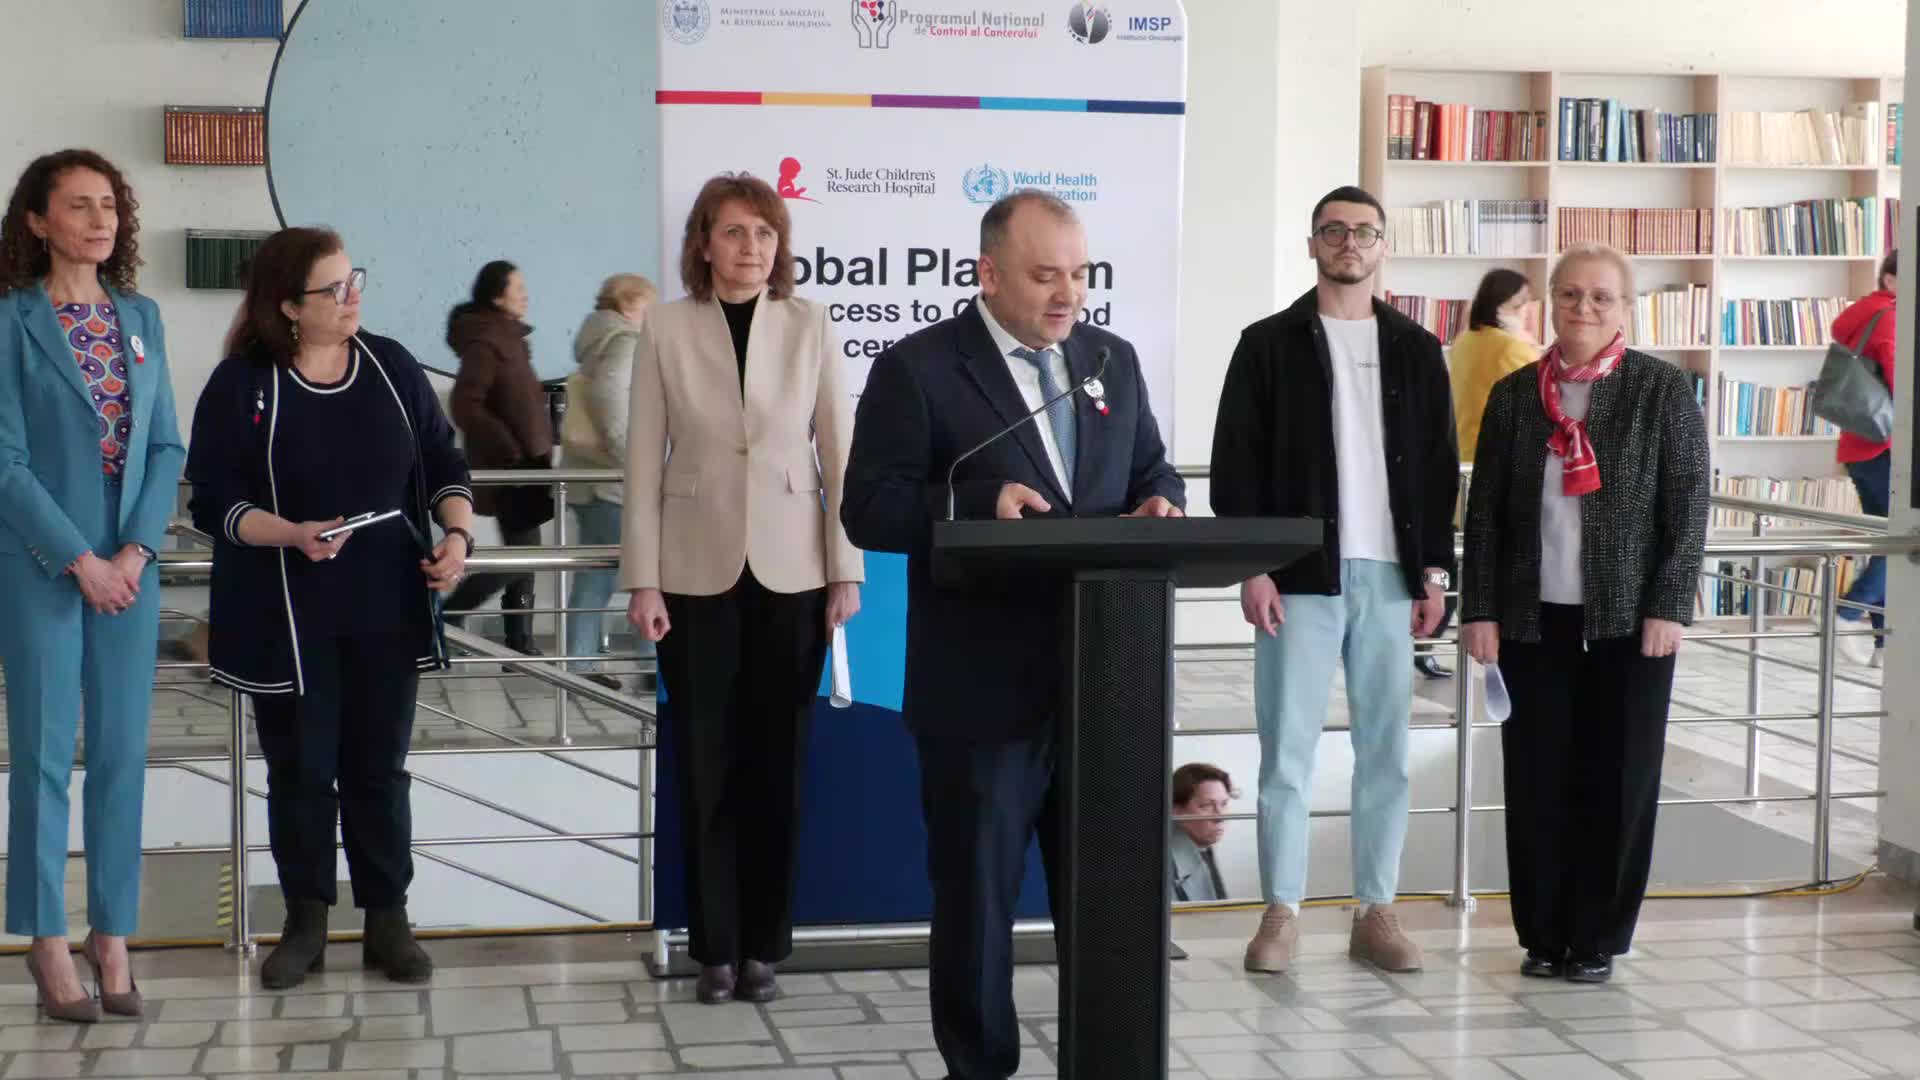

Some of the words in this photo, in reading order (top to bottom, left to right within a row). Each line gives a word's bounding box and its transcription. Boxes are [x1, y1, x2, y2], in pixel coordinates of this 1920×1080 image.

[900, 9, 976, 26] Programul
[1128, 17, 1171, 31] IMSP
[914, 25, 927, 36] de
[930, 26, 967, 37] Control
[970, 27, 981, 37] al
[984, 27, 1038, 38] Cancerului
[826, 167, 842, 180] St.
[845, 167, 872, 180] Jude
[1013, 171, 1051, 185] World
[1055, 172, 1097, 186] Health
[827, 180, 881, 193] Research
[885, 181, 936, 197] Hospital
[793, 247, 887, 286] obal
[830, 304, 900, 322] cess
[911, 300, 942, 323] to
